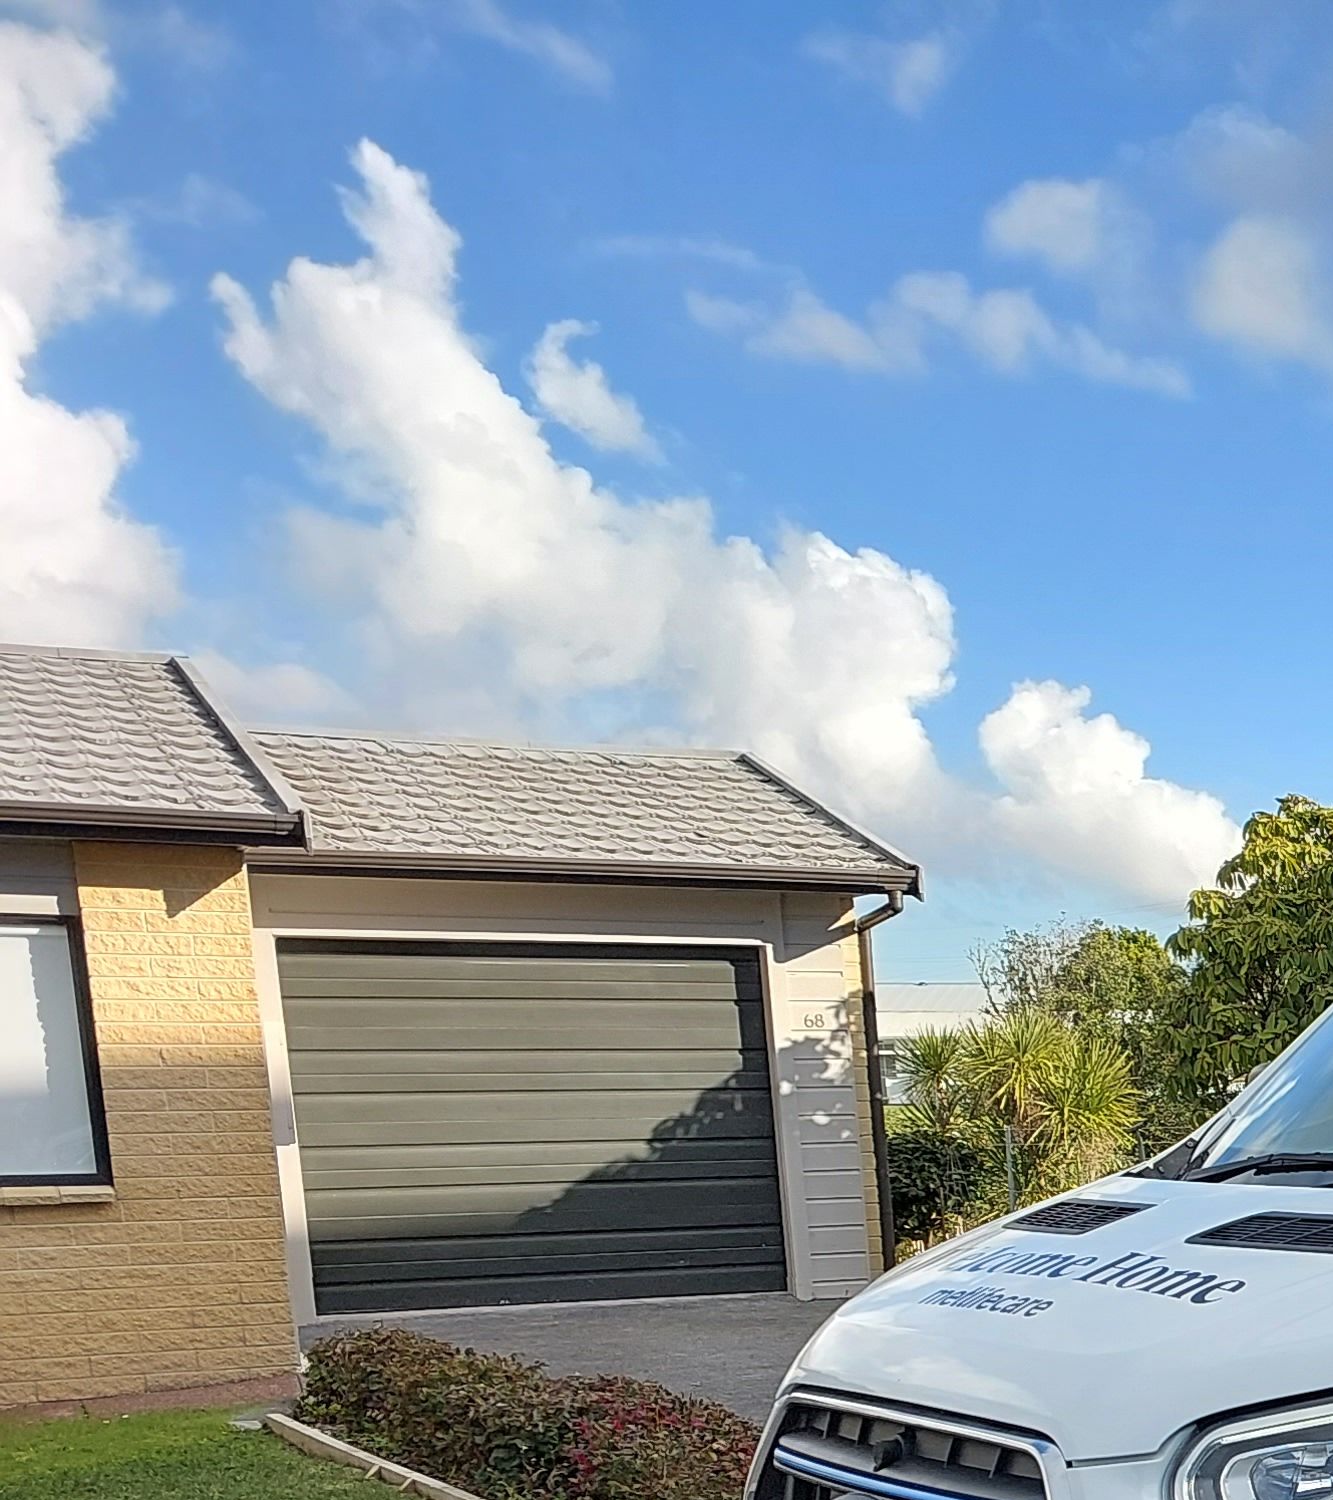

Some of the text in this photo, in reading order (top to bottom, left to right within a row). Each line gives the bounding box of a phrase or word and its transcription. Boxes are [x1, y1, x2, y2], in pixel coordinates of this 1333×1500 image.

[804, 1014, 824, 1028] 68
[1072, 1252, 1246, 1304] Home
[919, 1285, 1054, 1317] metlifecare
